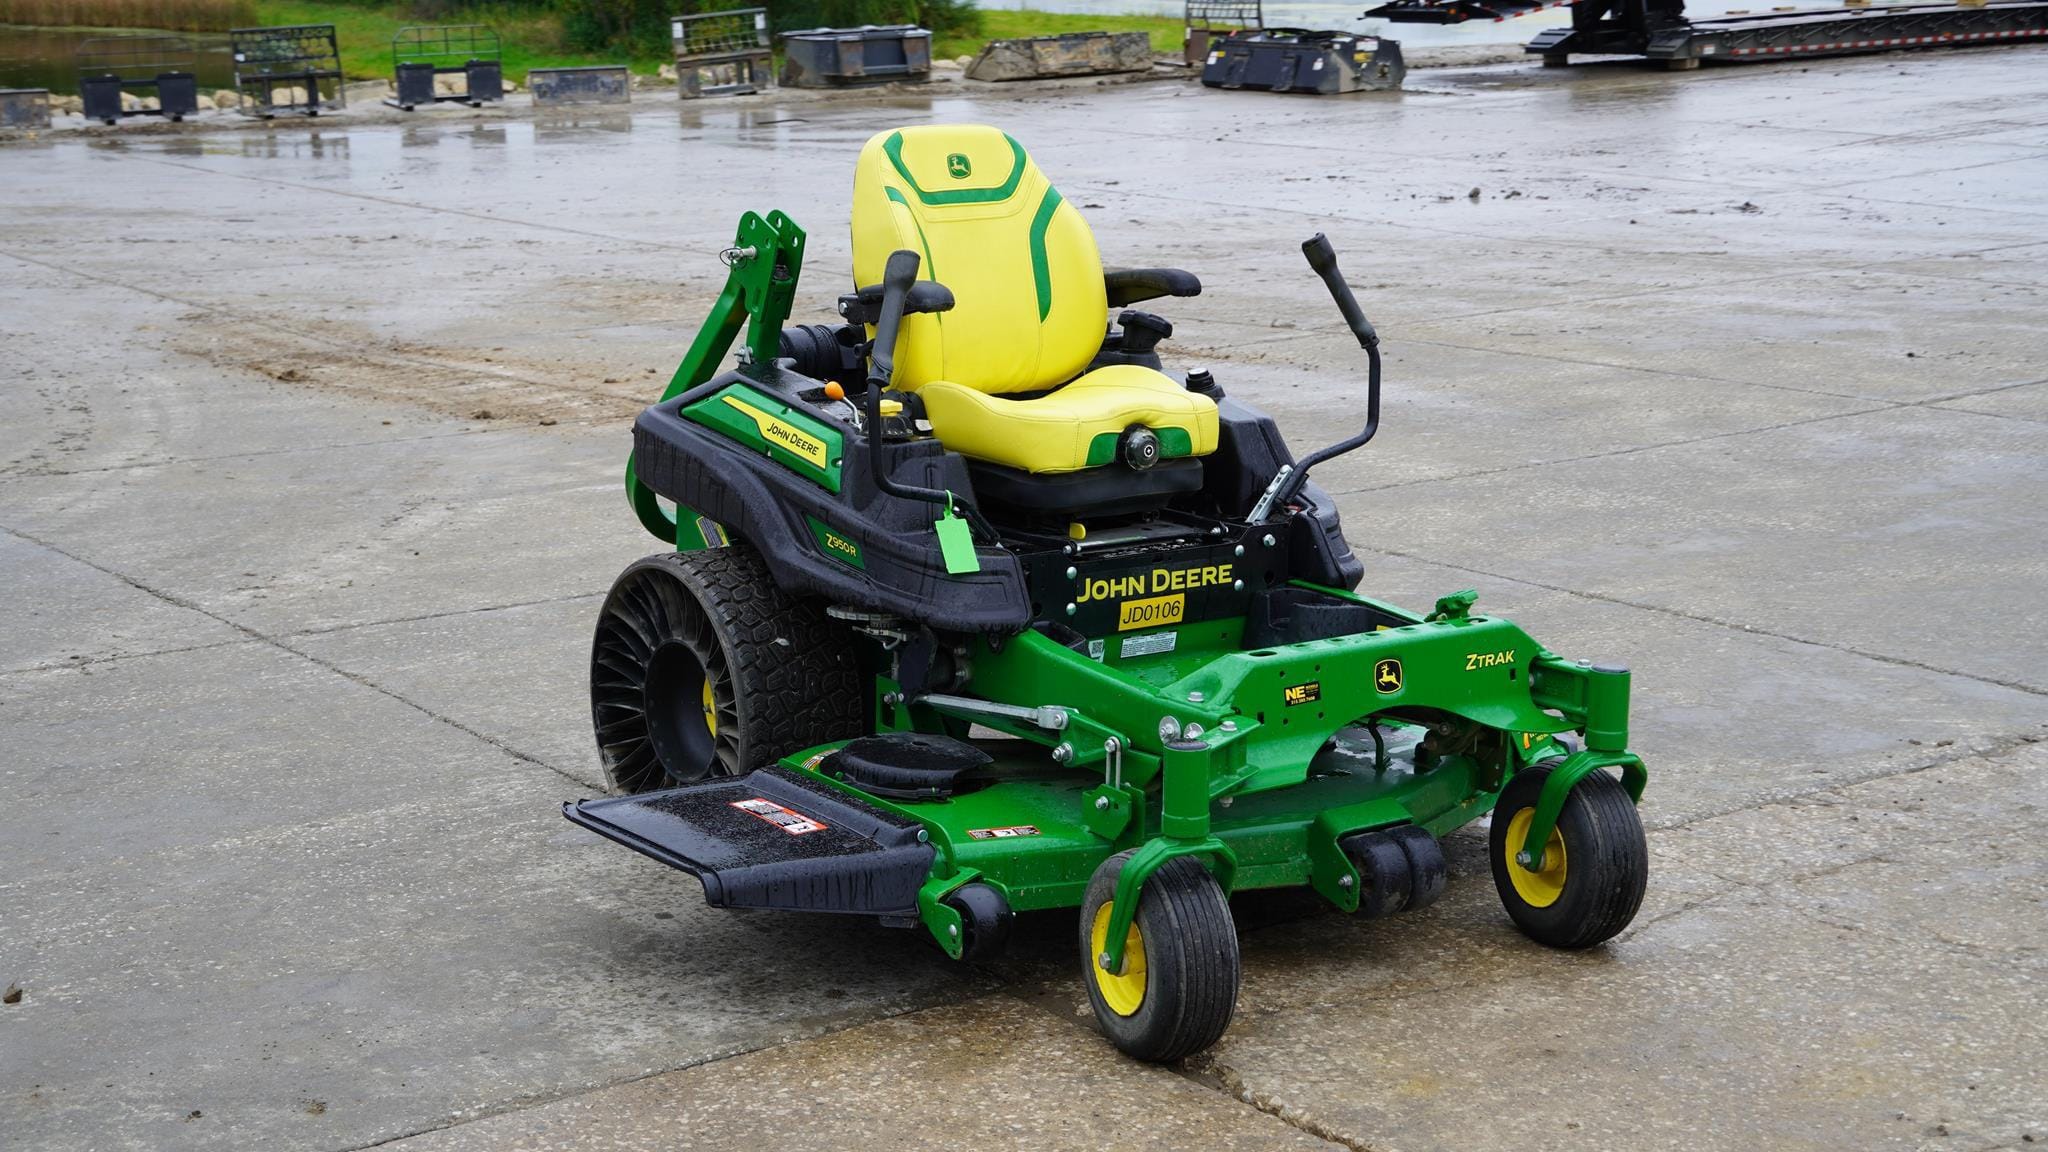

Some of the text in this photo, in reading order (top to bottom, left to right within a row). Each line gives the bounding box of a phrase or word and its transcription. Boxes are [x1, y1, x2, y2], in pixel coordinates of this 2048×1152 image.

[766, 422, 819, 456] JOHN DEERE
[825, 533, 857, 557] Z950R
[1076, 564, 1233, 603] JOHN DEERE
[1123, 600, 1182, 624] JD0106
[1465, 650, 1515, 671] ZTRAK
[1285, 686, 1306, 701] NE
